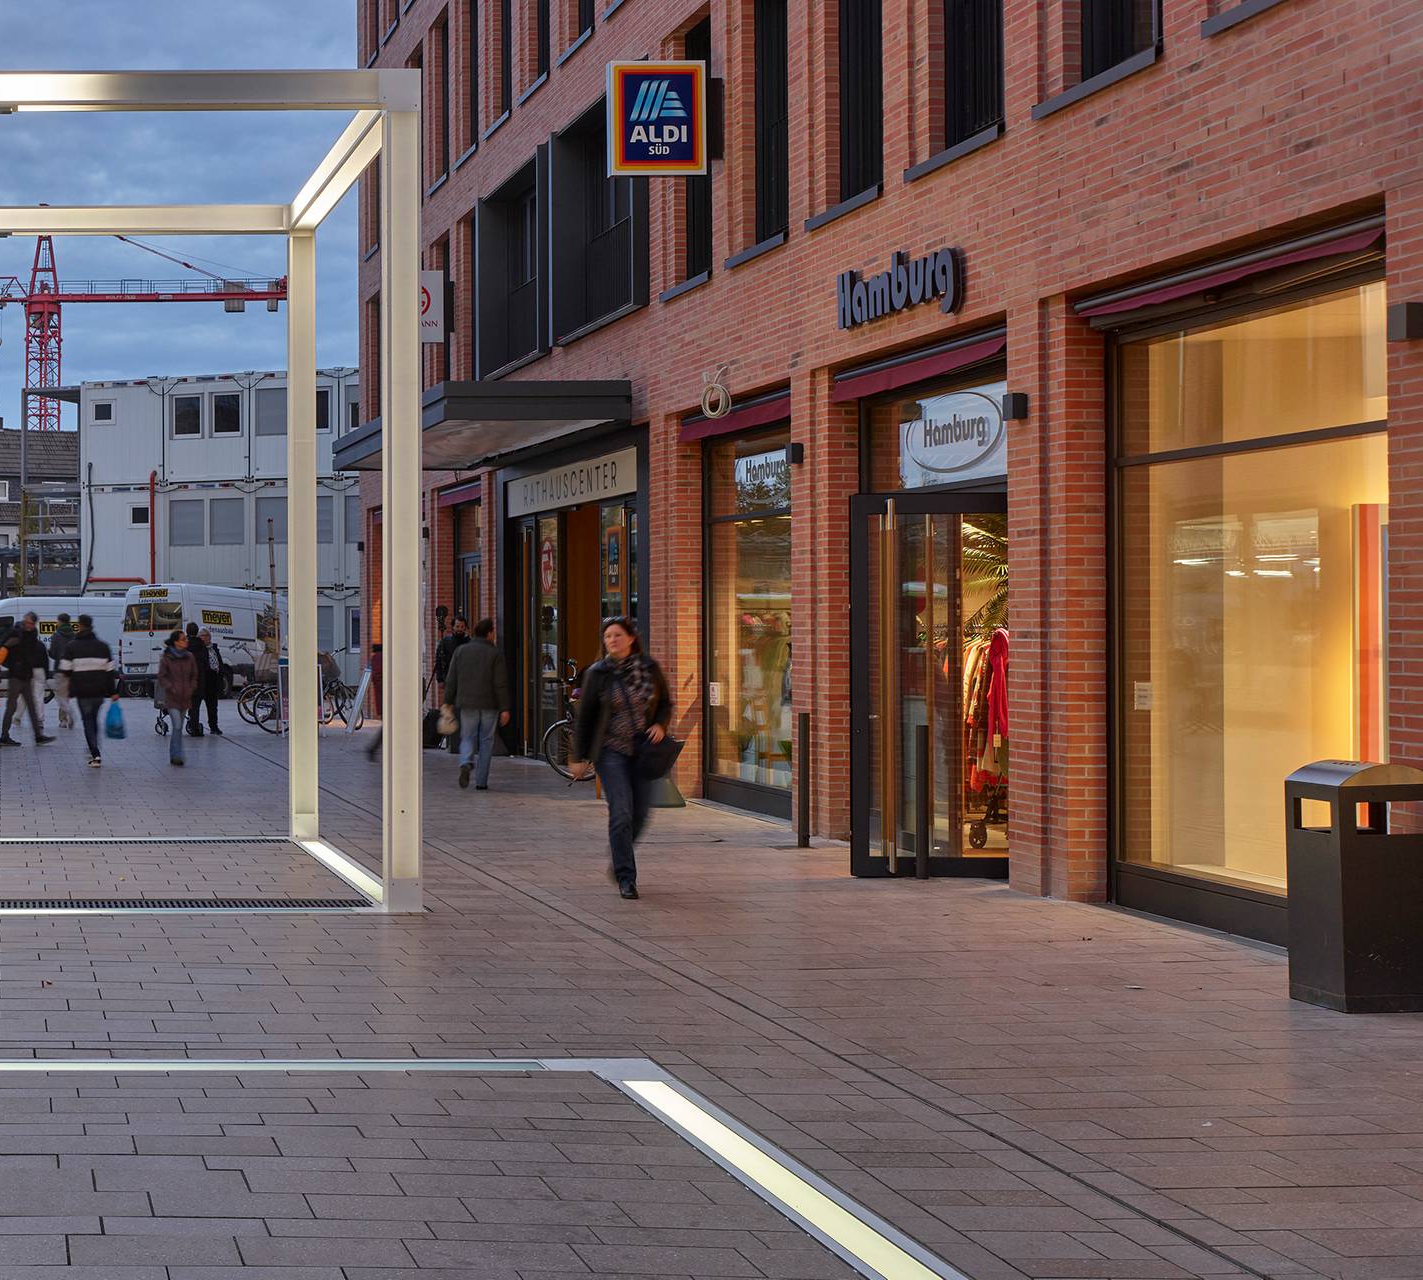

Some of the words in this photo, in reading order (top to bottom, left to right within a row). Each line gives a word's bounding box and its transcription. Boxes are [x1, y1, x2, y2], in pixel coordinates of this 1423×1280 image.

[629, 125, 688, 143] ALDI
[648, 143, 670, 155] SÜD
[836, 248, 956, 330] Hamburg
[923, 413, 987, 448] Hamburg
[523, 461, 618, 507] RATHAUSCENTER
[608, 564, 619, 576] ALDI
[140, 589, 167, 598] meyer
[204, 612, 231, 624] meyer
[208, 625, 234, 634] denausbau
